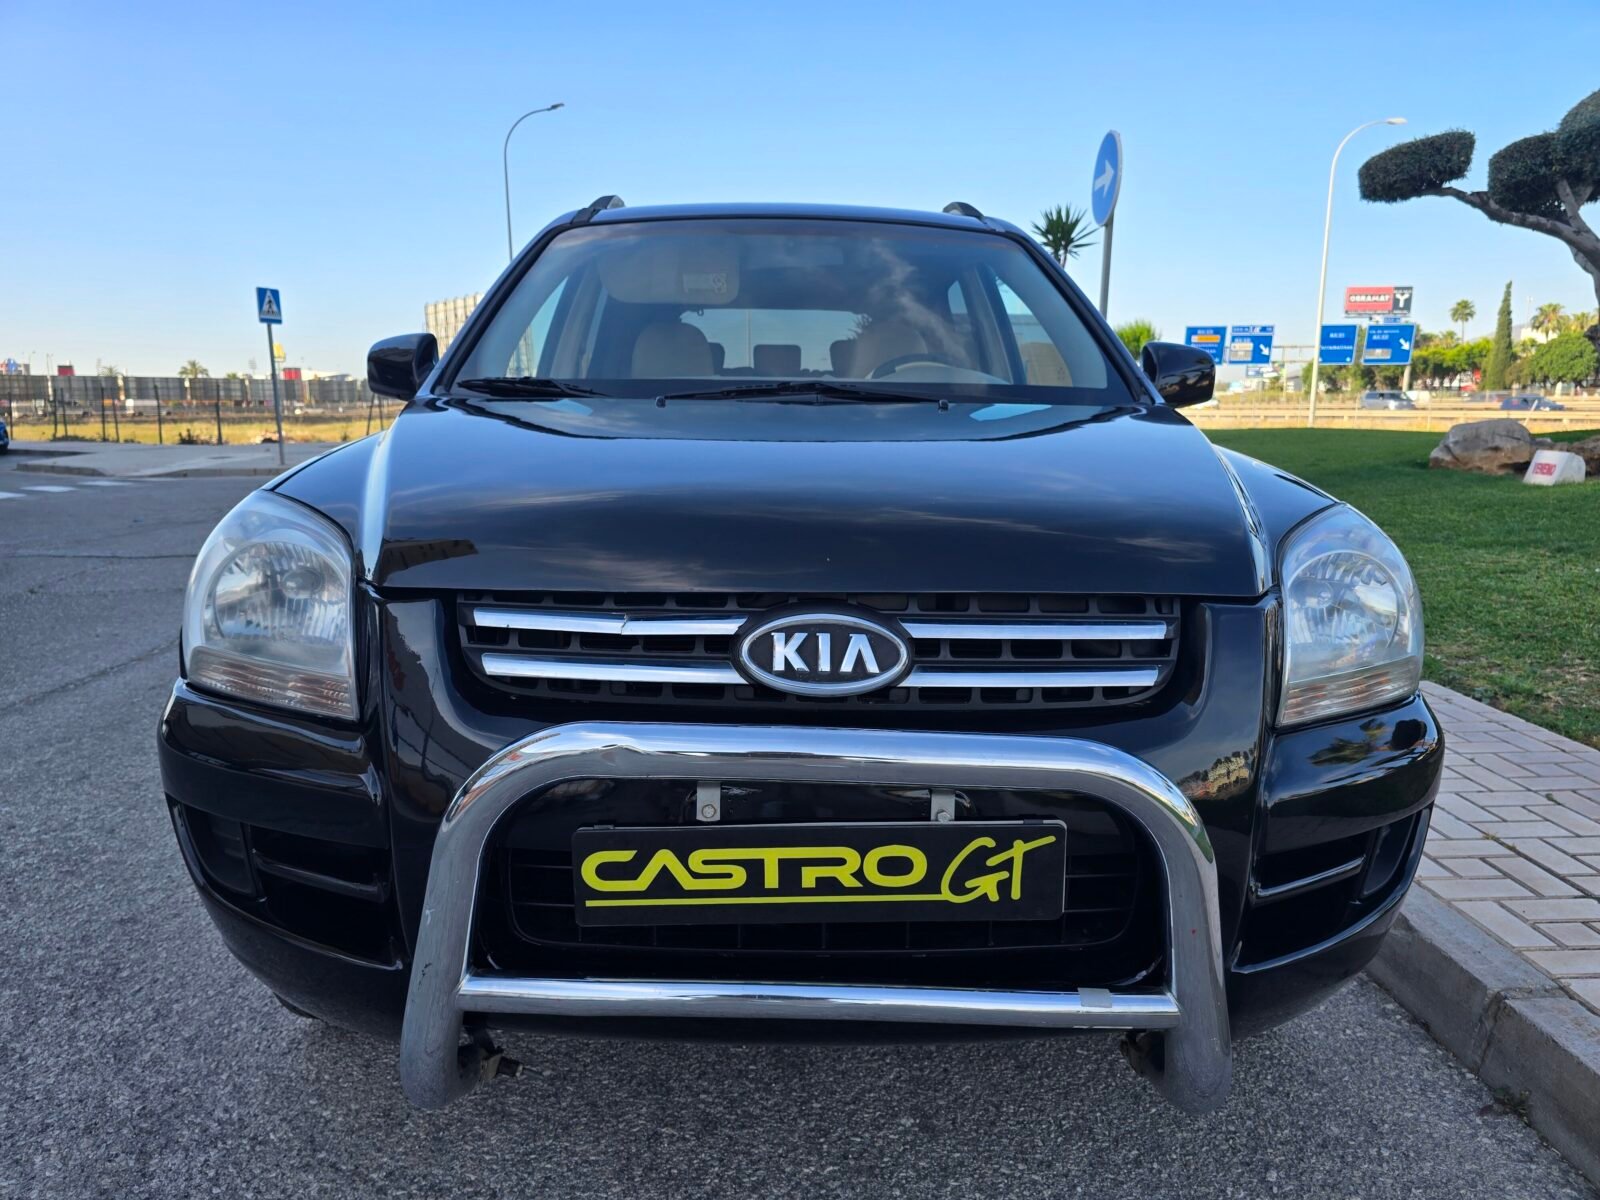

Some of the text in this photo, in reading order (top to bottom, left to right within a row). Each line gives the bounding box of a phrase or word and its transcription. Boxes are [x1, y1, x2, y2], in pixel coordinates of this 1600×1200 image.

[770, 631, 880, 674] KIA
[581, 836, 1056, 903] CASTRO GT
